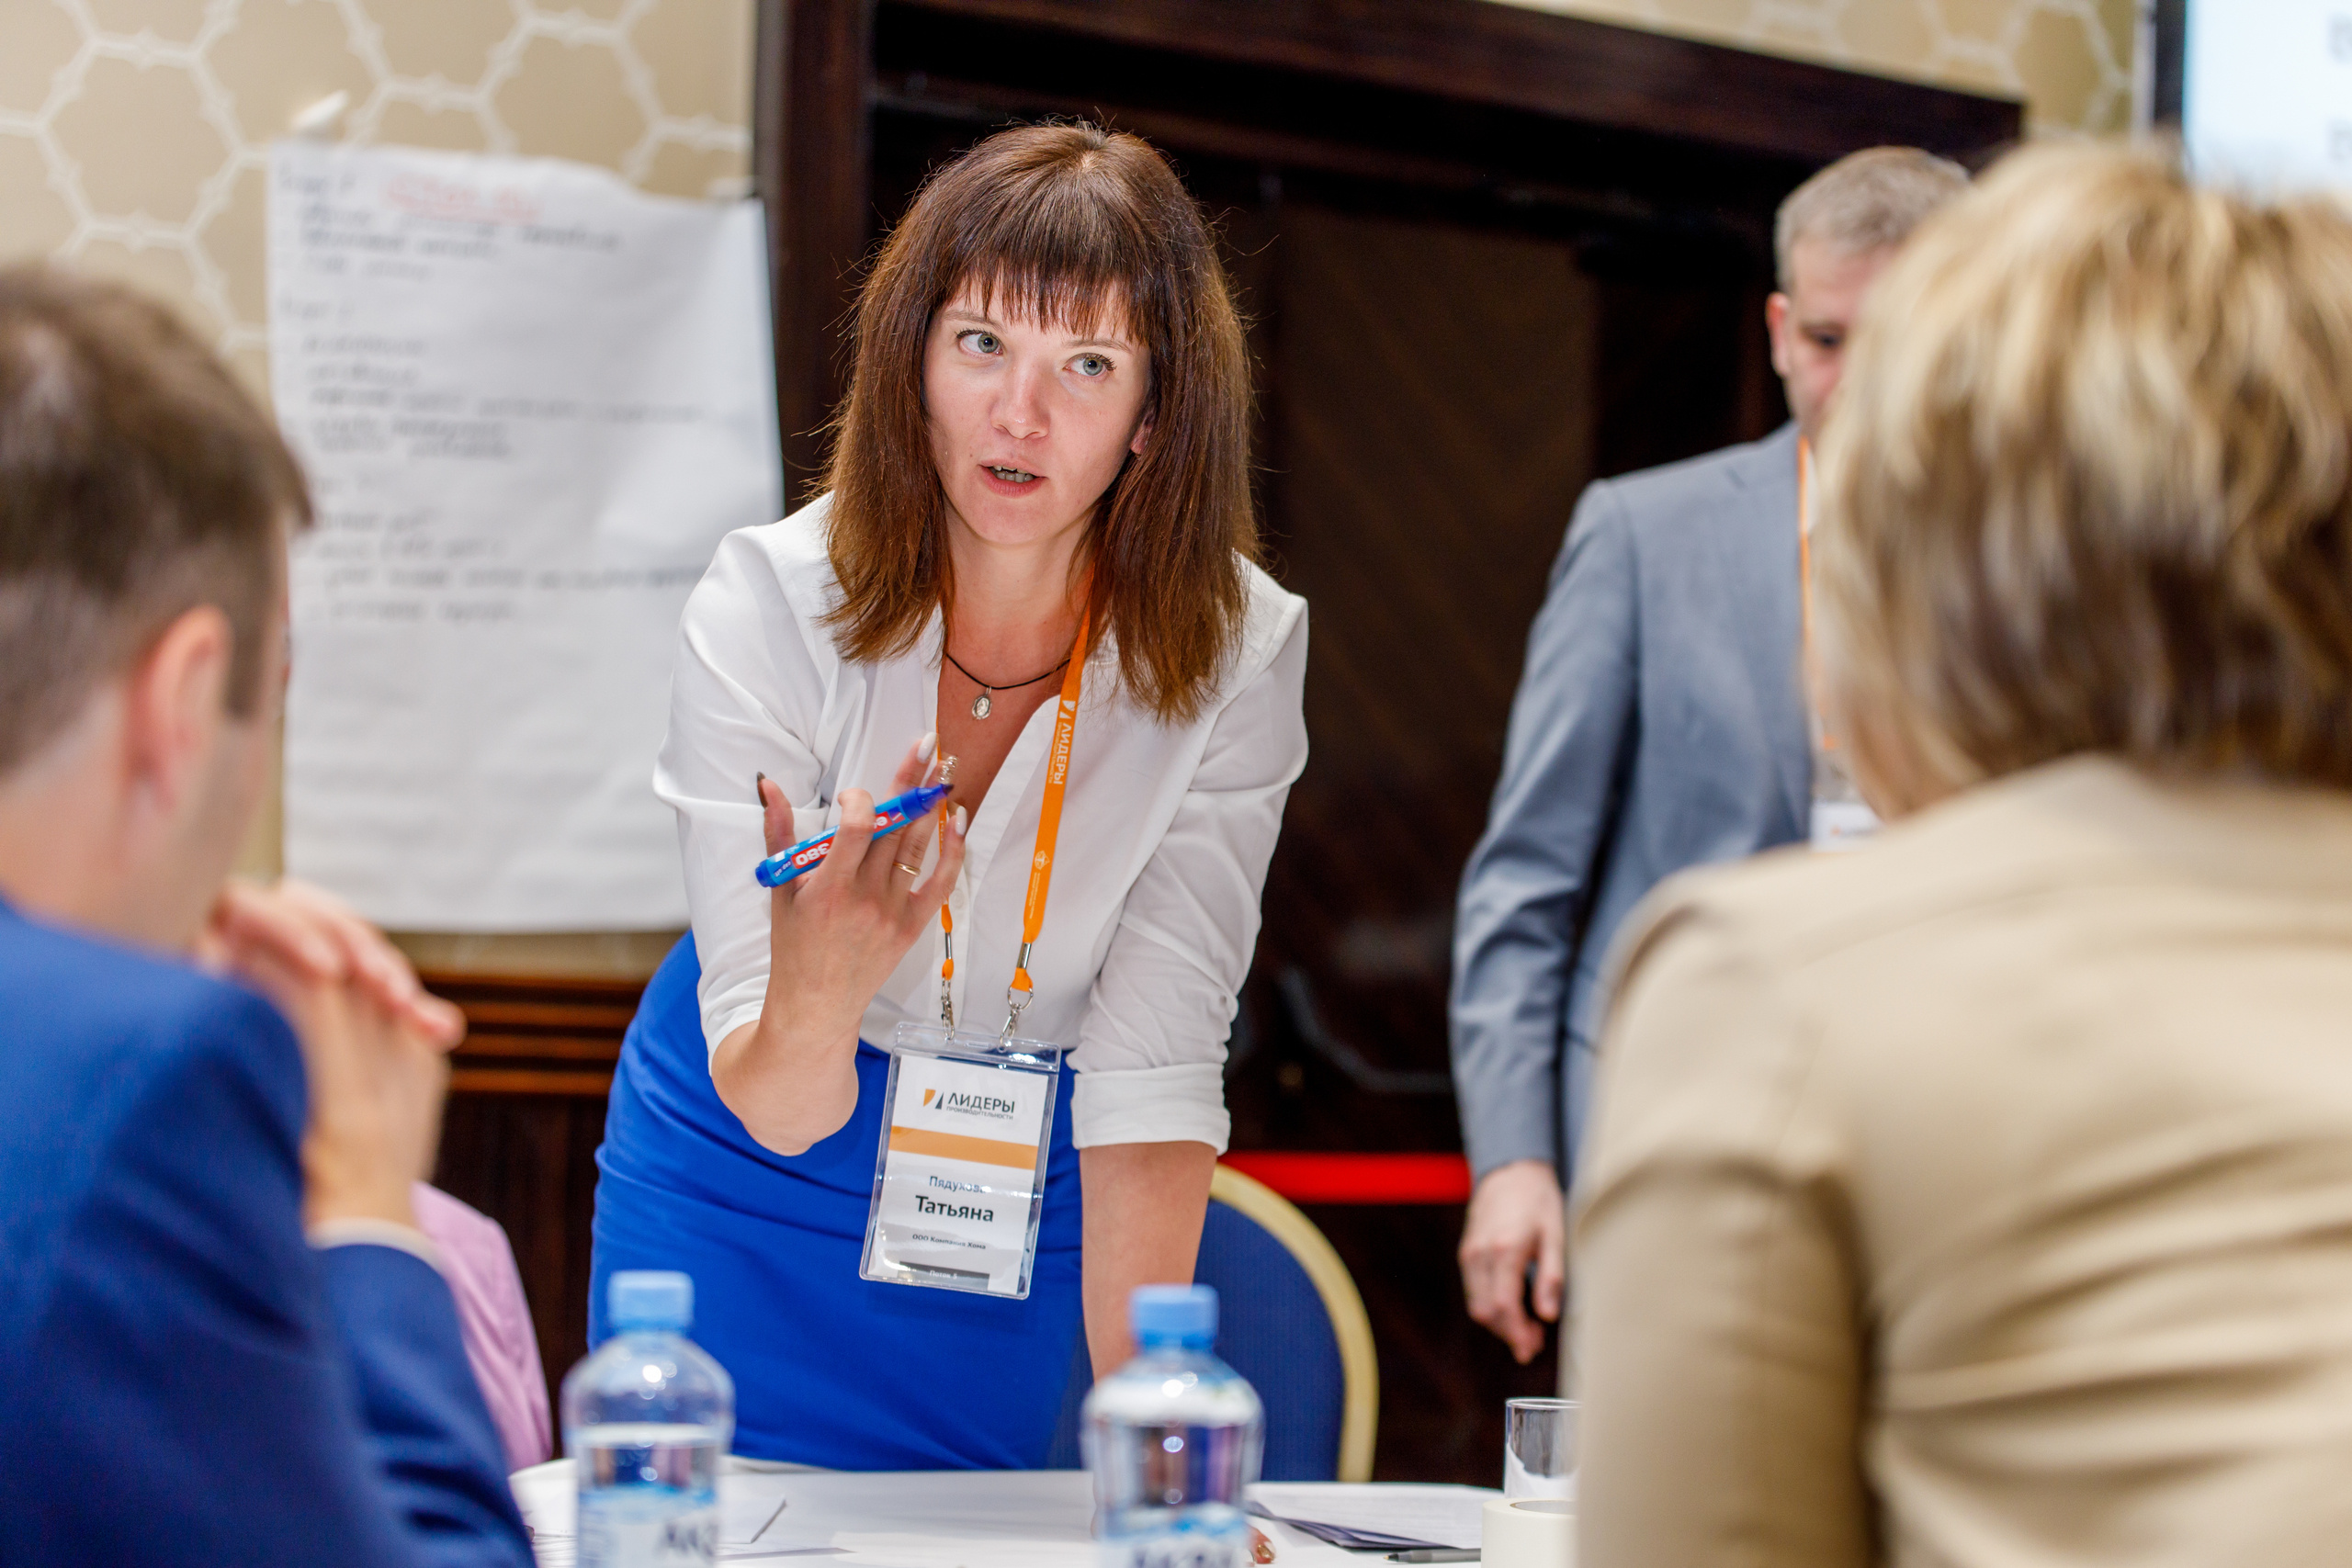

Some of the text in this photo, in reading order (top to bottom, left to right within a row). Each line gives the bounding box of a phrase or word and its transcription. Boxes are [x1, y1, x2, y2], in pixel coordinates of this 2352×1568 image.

[1053, 723, 1073, 784] ЛИДЕРЫ
[795, 842, 831, 866] 380
[946, 1106, 1013, 1120] ПРОИЗВОДИТЕЛЬНОСТИ
[947, 1092, 1015, 1113] ЛИДЕРЫ
[915, 1195, 994, 1222] Татьяна
